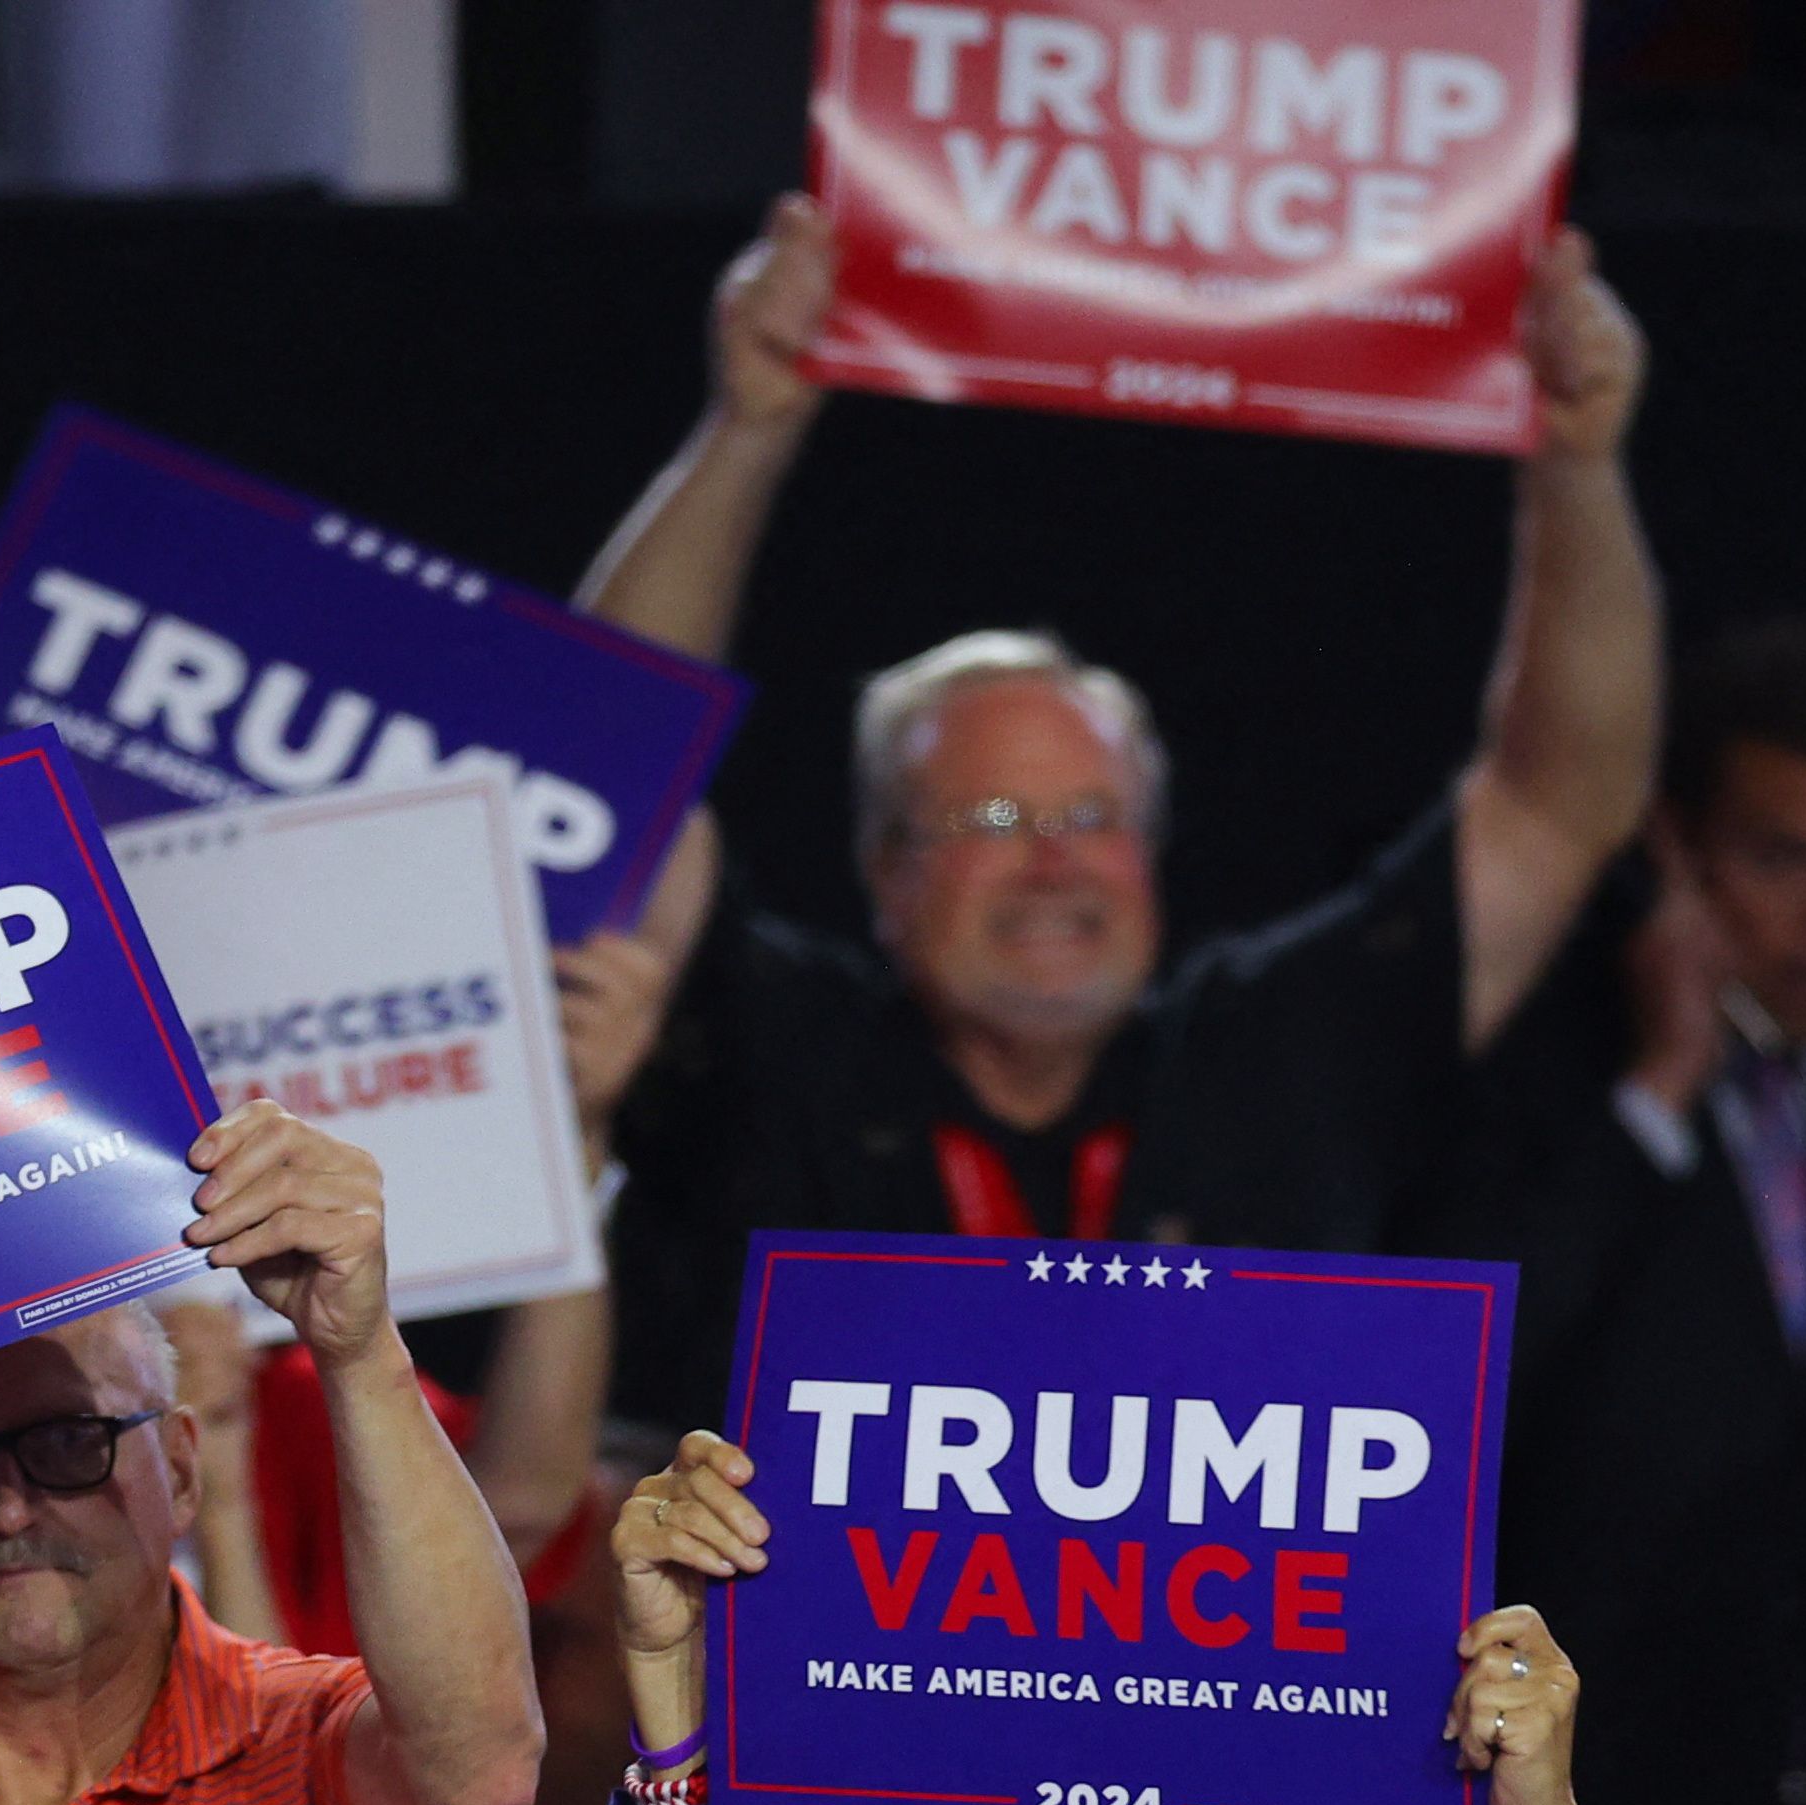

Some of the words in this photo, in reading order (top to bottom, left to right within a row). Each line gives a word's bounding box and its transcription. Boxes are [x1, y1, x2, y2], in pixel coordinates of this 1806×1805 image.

[885, 2, 1507, 166] TRUMP
[943, 131, 1433, 266] VANCE
[786, 1379, 1433, 1534] TRUMP
[844, 1526, 1350, 1654] VANCE
[806, 1660, 915, 1693] MAKE
[926, 1666, 1102, 1703] AMERICA
[1113, 1676, 1240, 1712] GREAT
[1252, 1682, 1390, 1718] AGAIN!
